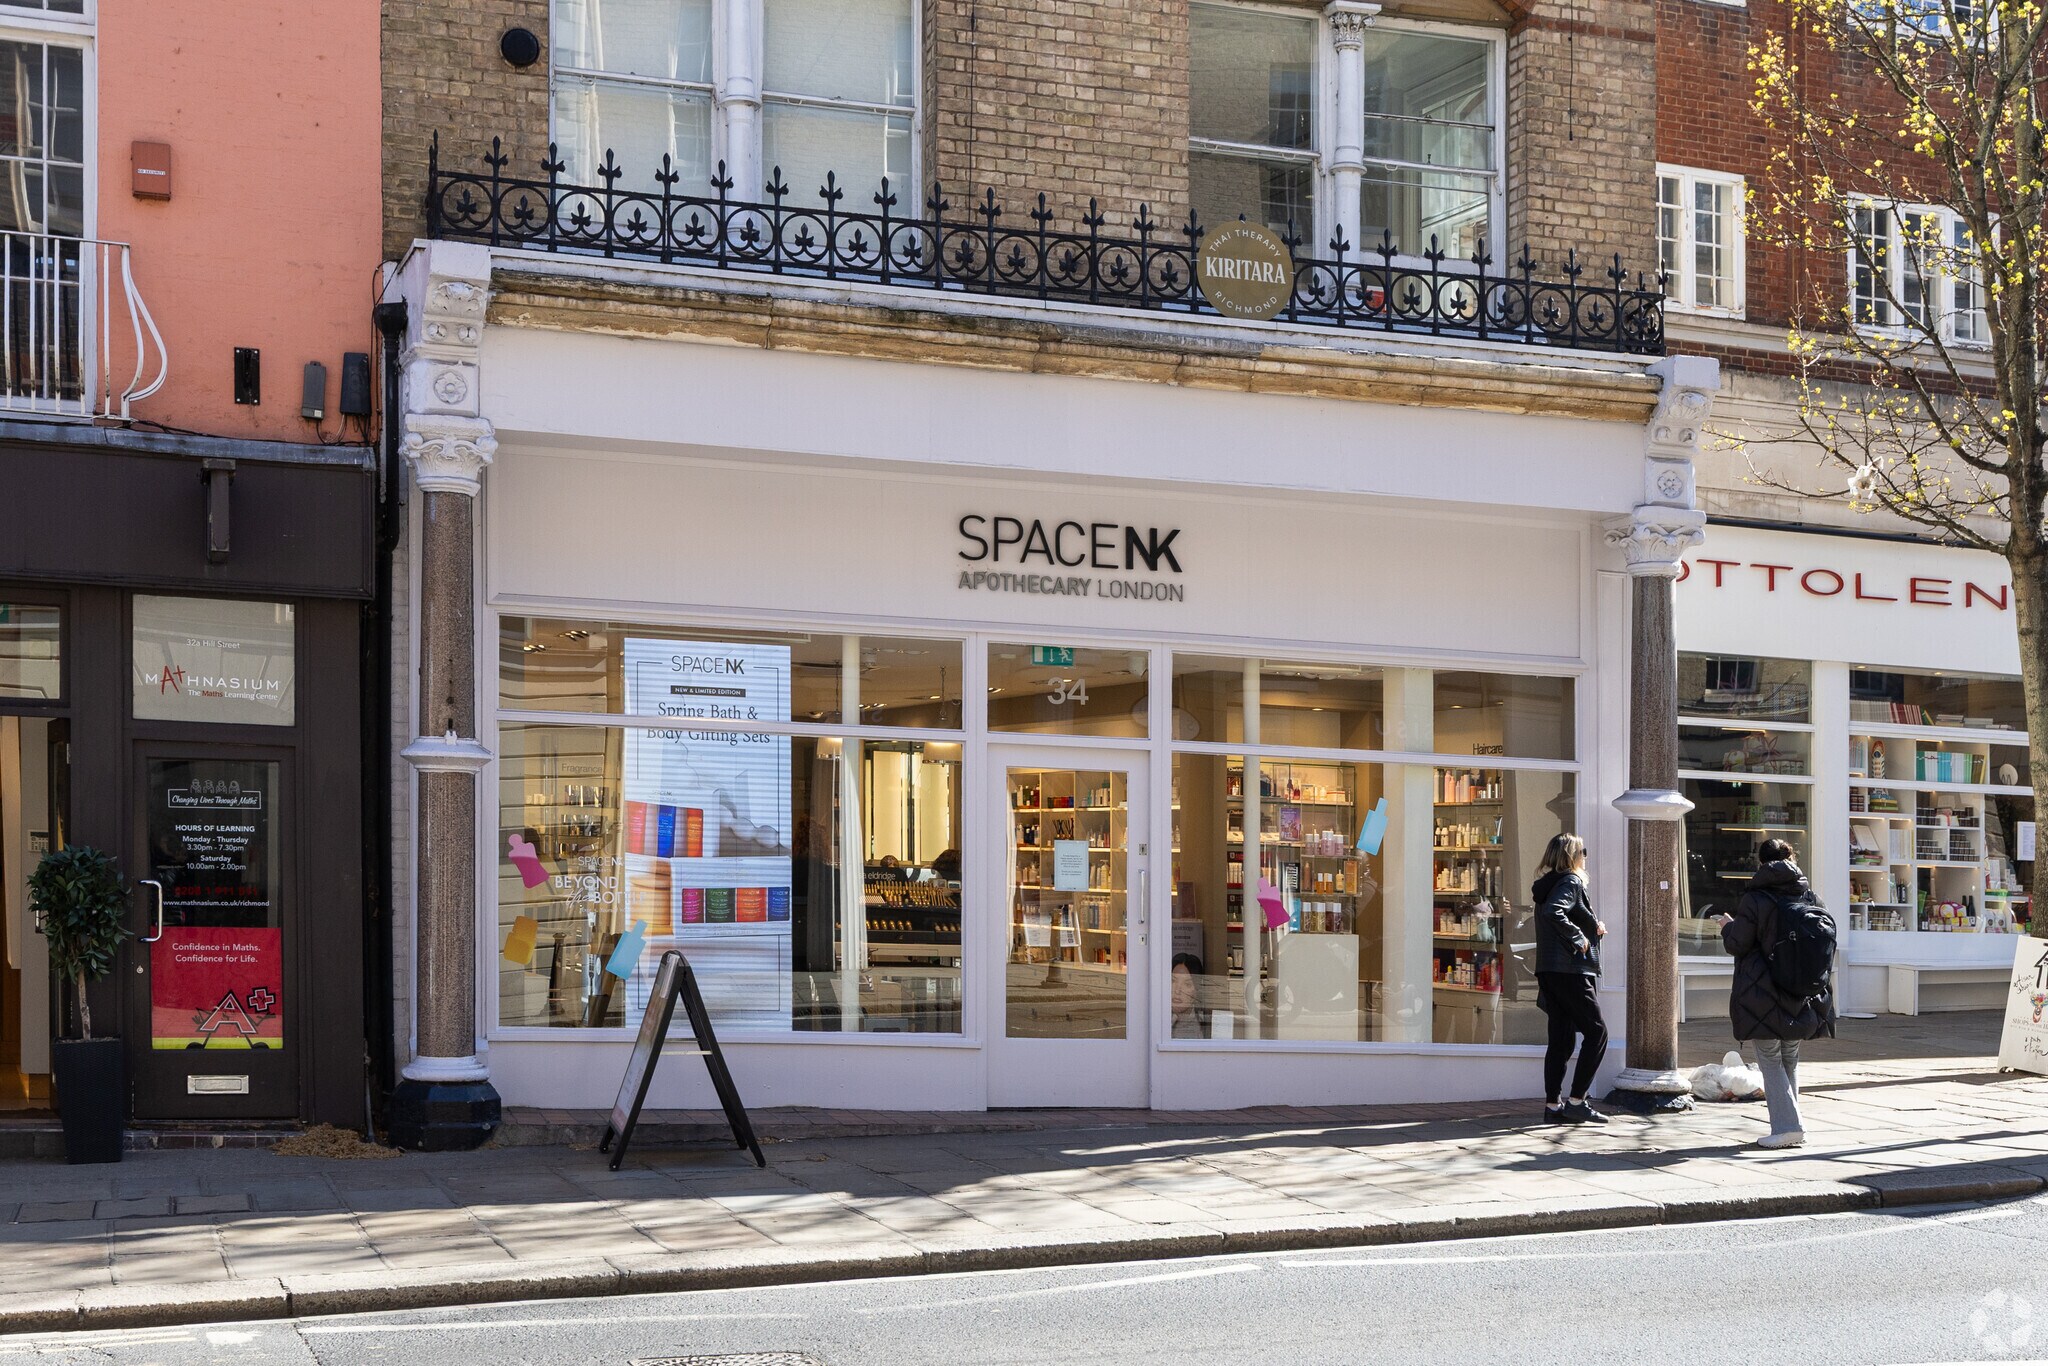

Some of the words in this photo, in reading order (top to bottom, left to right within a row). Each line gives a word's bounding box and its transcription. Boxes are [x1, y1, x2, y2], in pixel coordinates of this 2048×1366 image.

[1209, 231, 1231, 252] THAI
[1234, 229, 1281, 257] THERAPY
[1205, 256, 1286, 285] KIRITARA
[1214, 290, 1278, 314] RICHMOND
[958, 514, 1183, 573] SPACENK
[958, 571, 1092, 597] APOTHECARY
[1097, 579, 1184, 602] LONDON
[186, 638, 200, 647] 32a
[202, 639, 216, 648] Hill
[217, 640, 241, 649] Street
[671, 655, 744, 675] SPACENK
[188, 689, 201, 697] The
[202, 690, 223, 698] Maths
[224, 691, 255, 700] Learning
[255, 692, 278, 700] Centre
[1047, 676, 1089, 706] 34
[658, 702, 705, 718] Spring
[710, 704, 741, 719] Bath
[747, 706, 758, 720] &
[646, 728, 682, 743] Body
[1472, 743, 1504, 756] Haircare
[171, 794, 199, 806] Changing
[199, 795, 215, 805] Lives
[214, 795, 238, 807] Through
[175, 824, 202, 832] HOURS
[216, 825, 255, 833] LEARNING
[182, 835, 211, 844] Monday
[217, 836, 249, 844] Thursday
[187, 844, 213, 852] 3.30pm
[219, 844, 245, 852] 7.30pm
[200, 854, 232, 863] Saturday
[220, 863, 247, 871] 2.00pm
[555, 876, 619, 889] BEYOND
[867, 872, 896, 881] eldridge
[565, 888, 595, 908] the
[172, 943, 220, 951] Confidence
[222, 943, 230, 951] in
[232, 943, 261, 951] Maths.
[175, 954, 223, 962] Confidence
[240, 955, 258, 963] Life.
